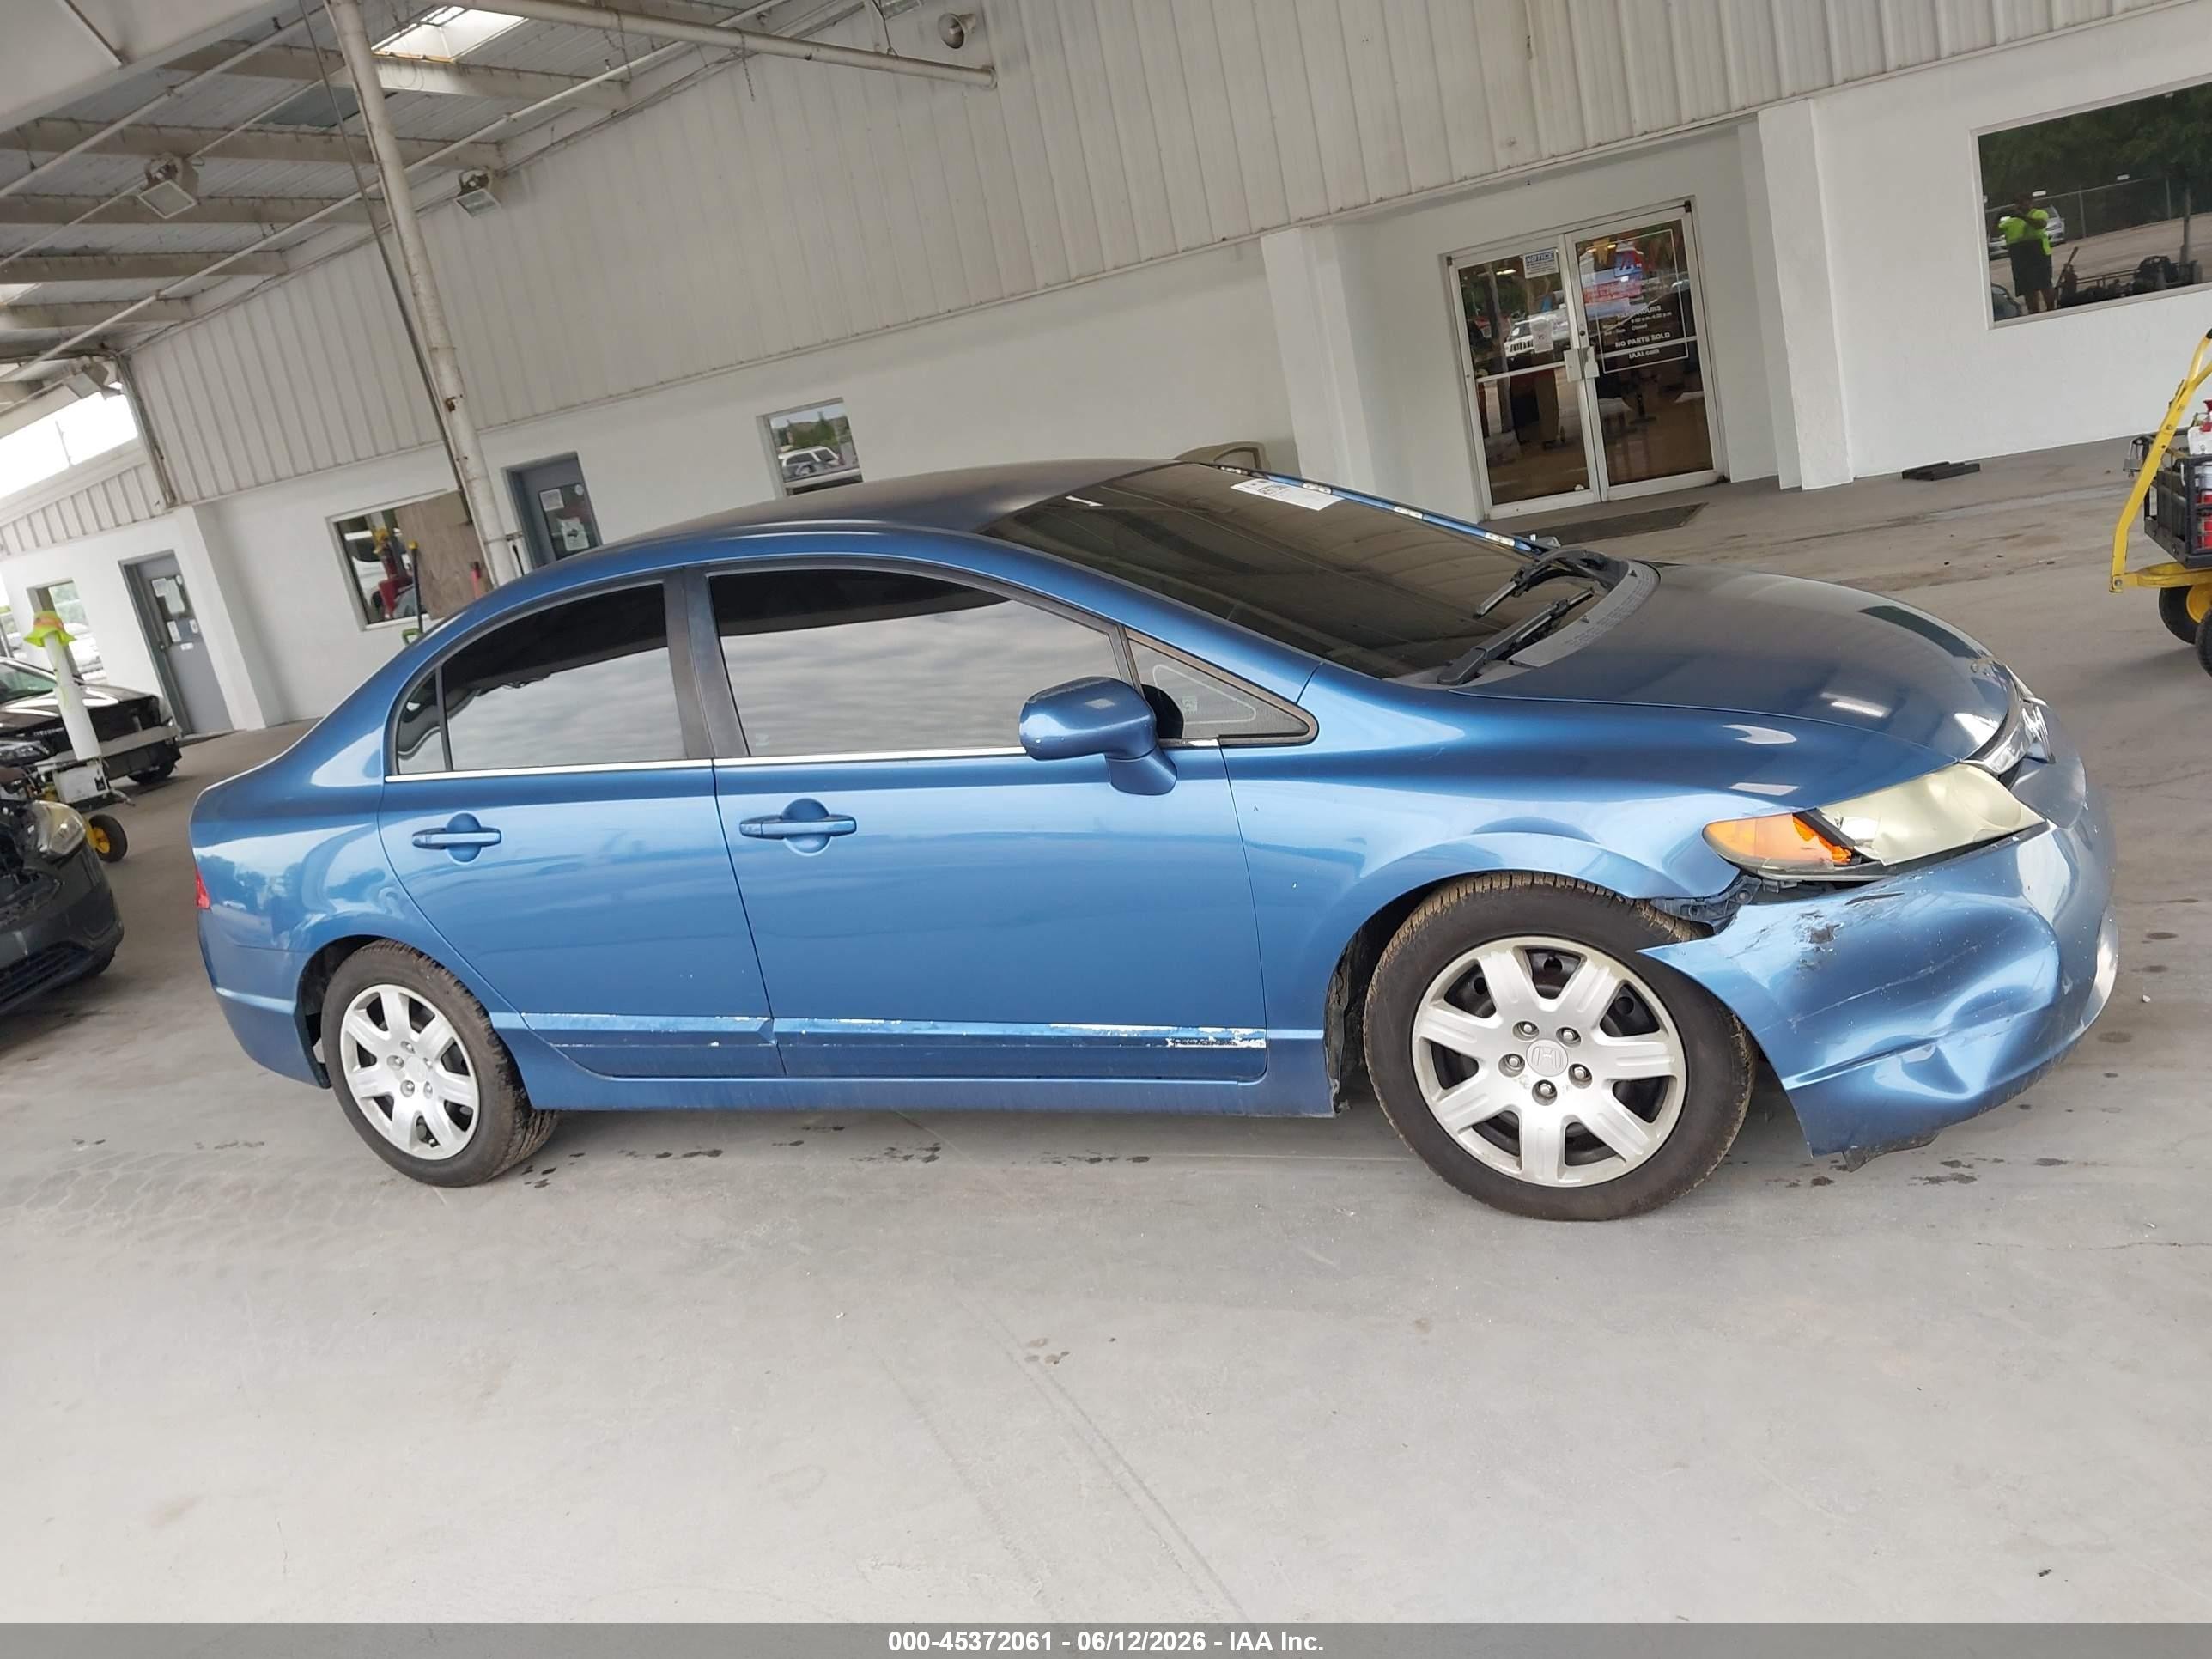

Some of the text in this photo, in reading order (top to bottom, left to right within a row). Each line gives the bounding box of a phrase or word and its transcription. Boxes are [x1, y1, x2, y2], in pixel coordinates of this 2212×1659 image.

[1614, 331, 1671, 349] NO PARTS SOLD
